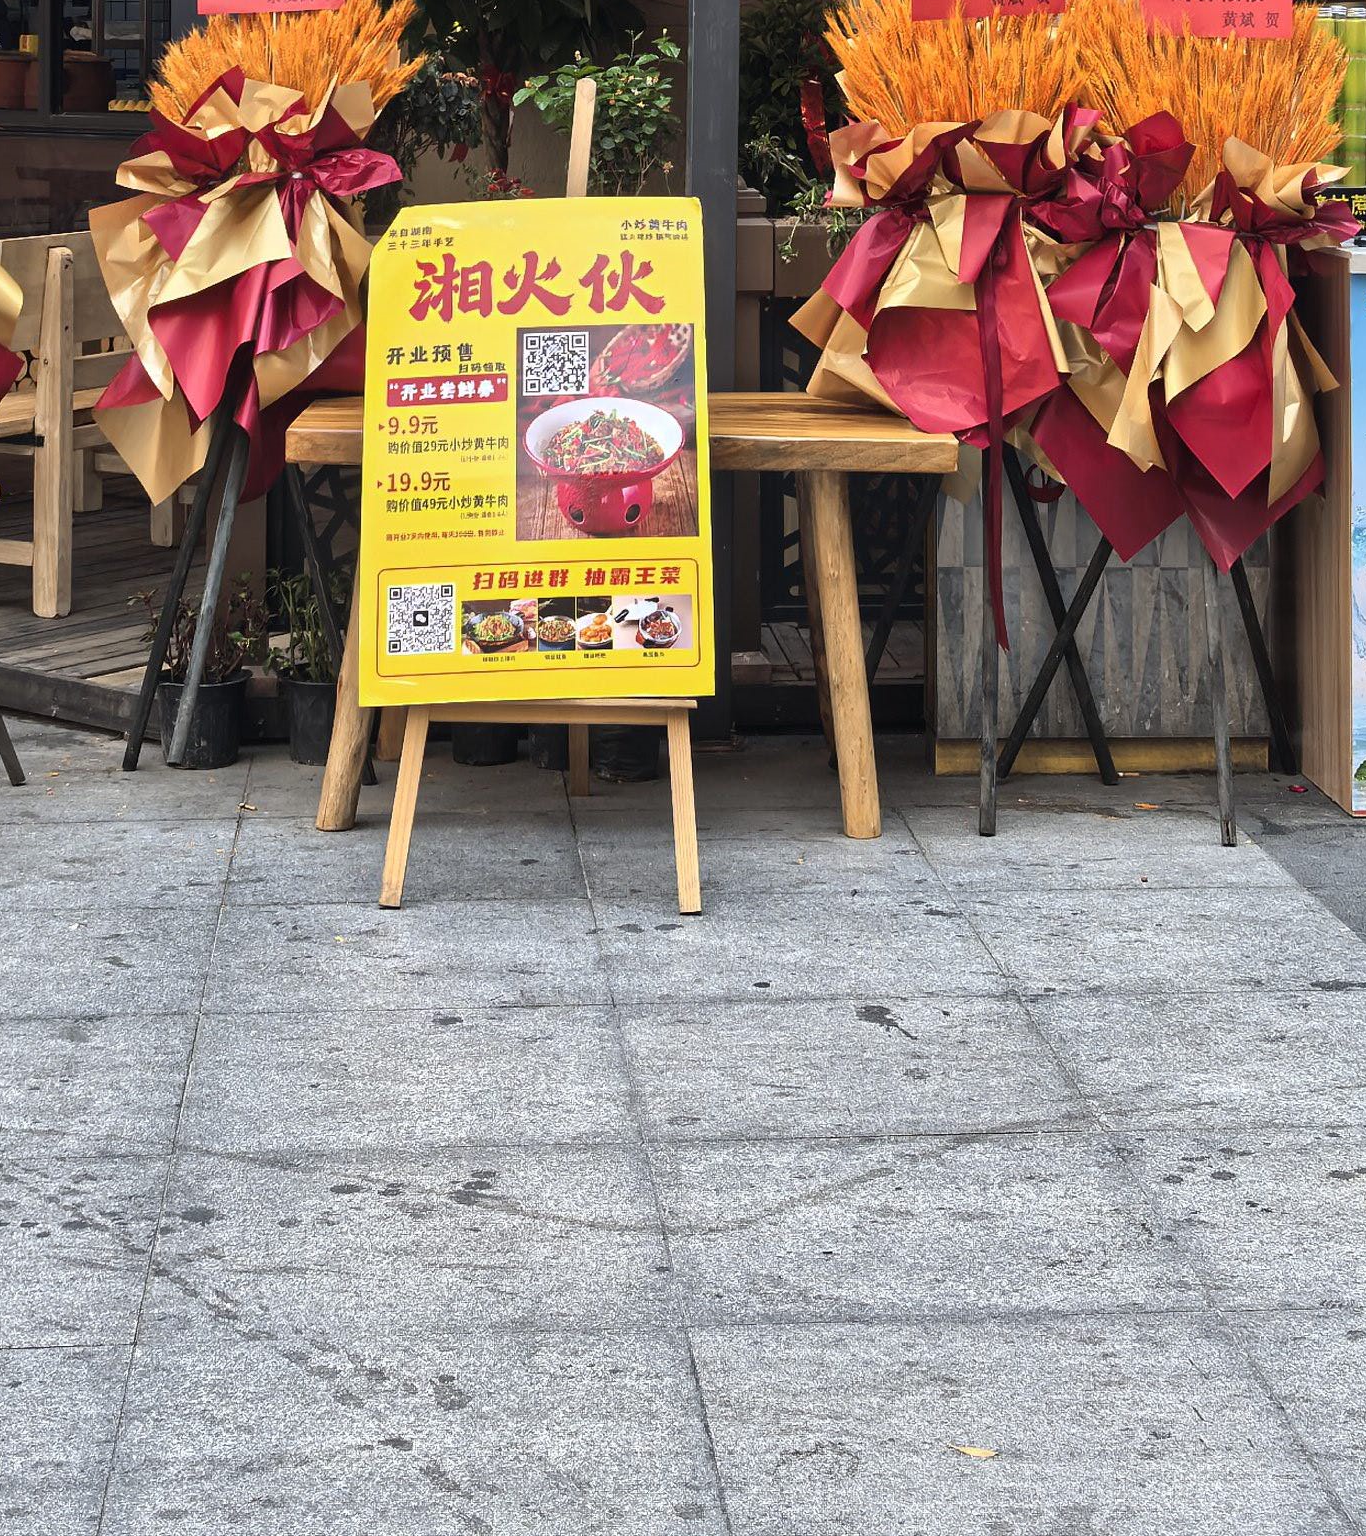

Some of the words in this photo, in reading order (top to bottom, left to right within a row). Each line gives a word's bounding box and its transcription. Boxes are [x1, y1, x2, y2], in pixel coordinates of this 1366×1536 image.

[1266, 11, 1280, 29] 贺
[621, 218, 688, 232] 小炒黄牛肉
[409, 249, 666, 323] 湘火伙
[386, 343, 473, 365] 开业预售
[459, 362, 506, 374] 扫码领取
[388, 415, 439, 436] 9.9元
[388, 437, 510, 456] 购价值29元小炒黄牛肉
[387, 471, 451, 494] 19.9元
[387, 493, 509, 514] 购价值49元小炒黄牛肉
[472, 568, 569, 591] 扫码进群
[584, 564, 683, 587] 抽霸王菜
